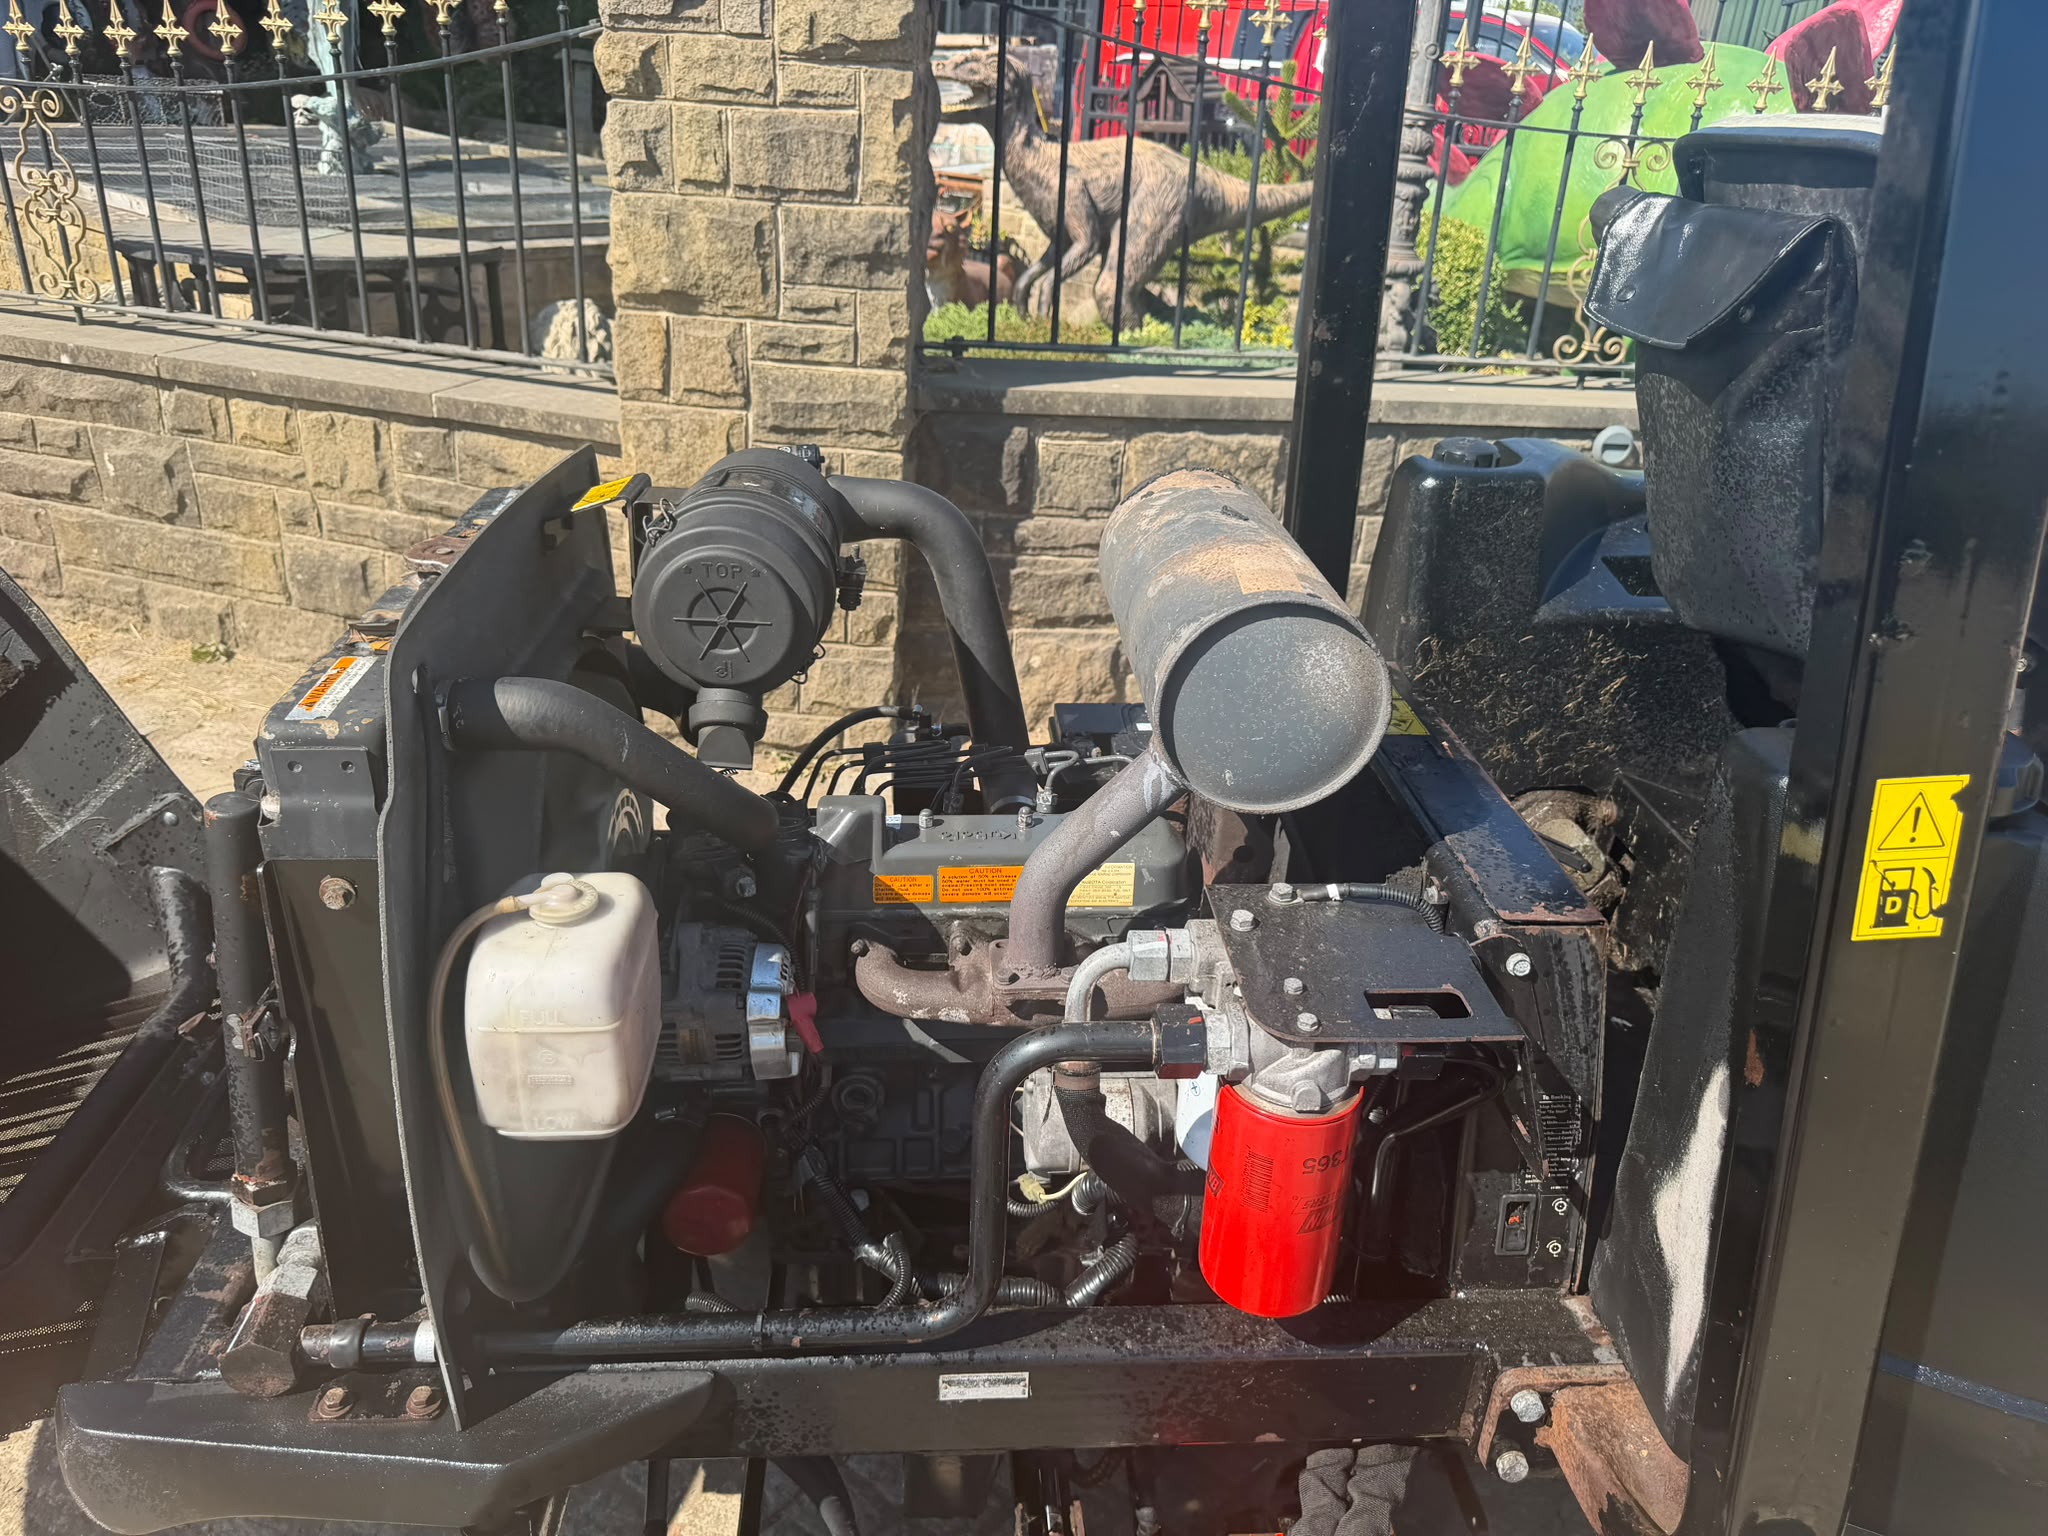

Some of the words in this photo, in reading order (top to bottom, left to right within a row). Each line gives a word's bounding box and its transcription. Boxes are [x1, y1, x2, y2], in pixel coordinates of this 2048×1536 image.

[700, 561, 742, 579] TOP
[1884, 896, 1903, 915] D
[519, 1009, 565, 1025] FULL
[533, 1114, 577, 1130] LOW
[1302, 1149, 1345, 1175] 365
